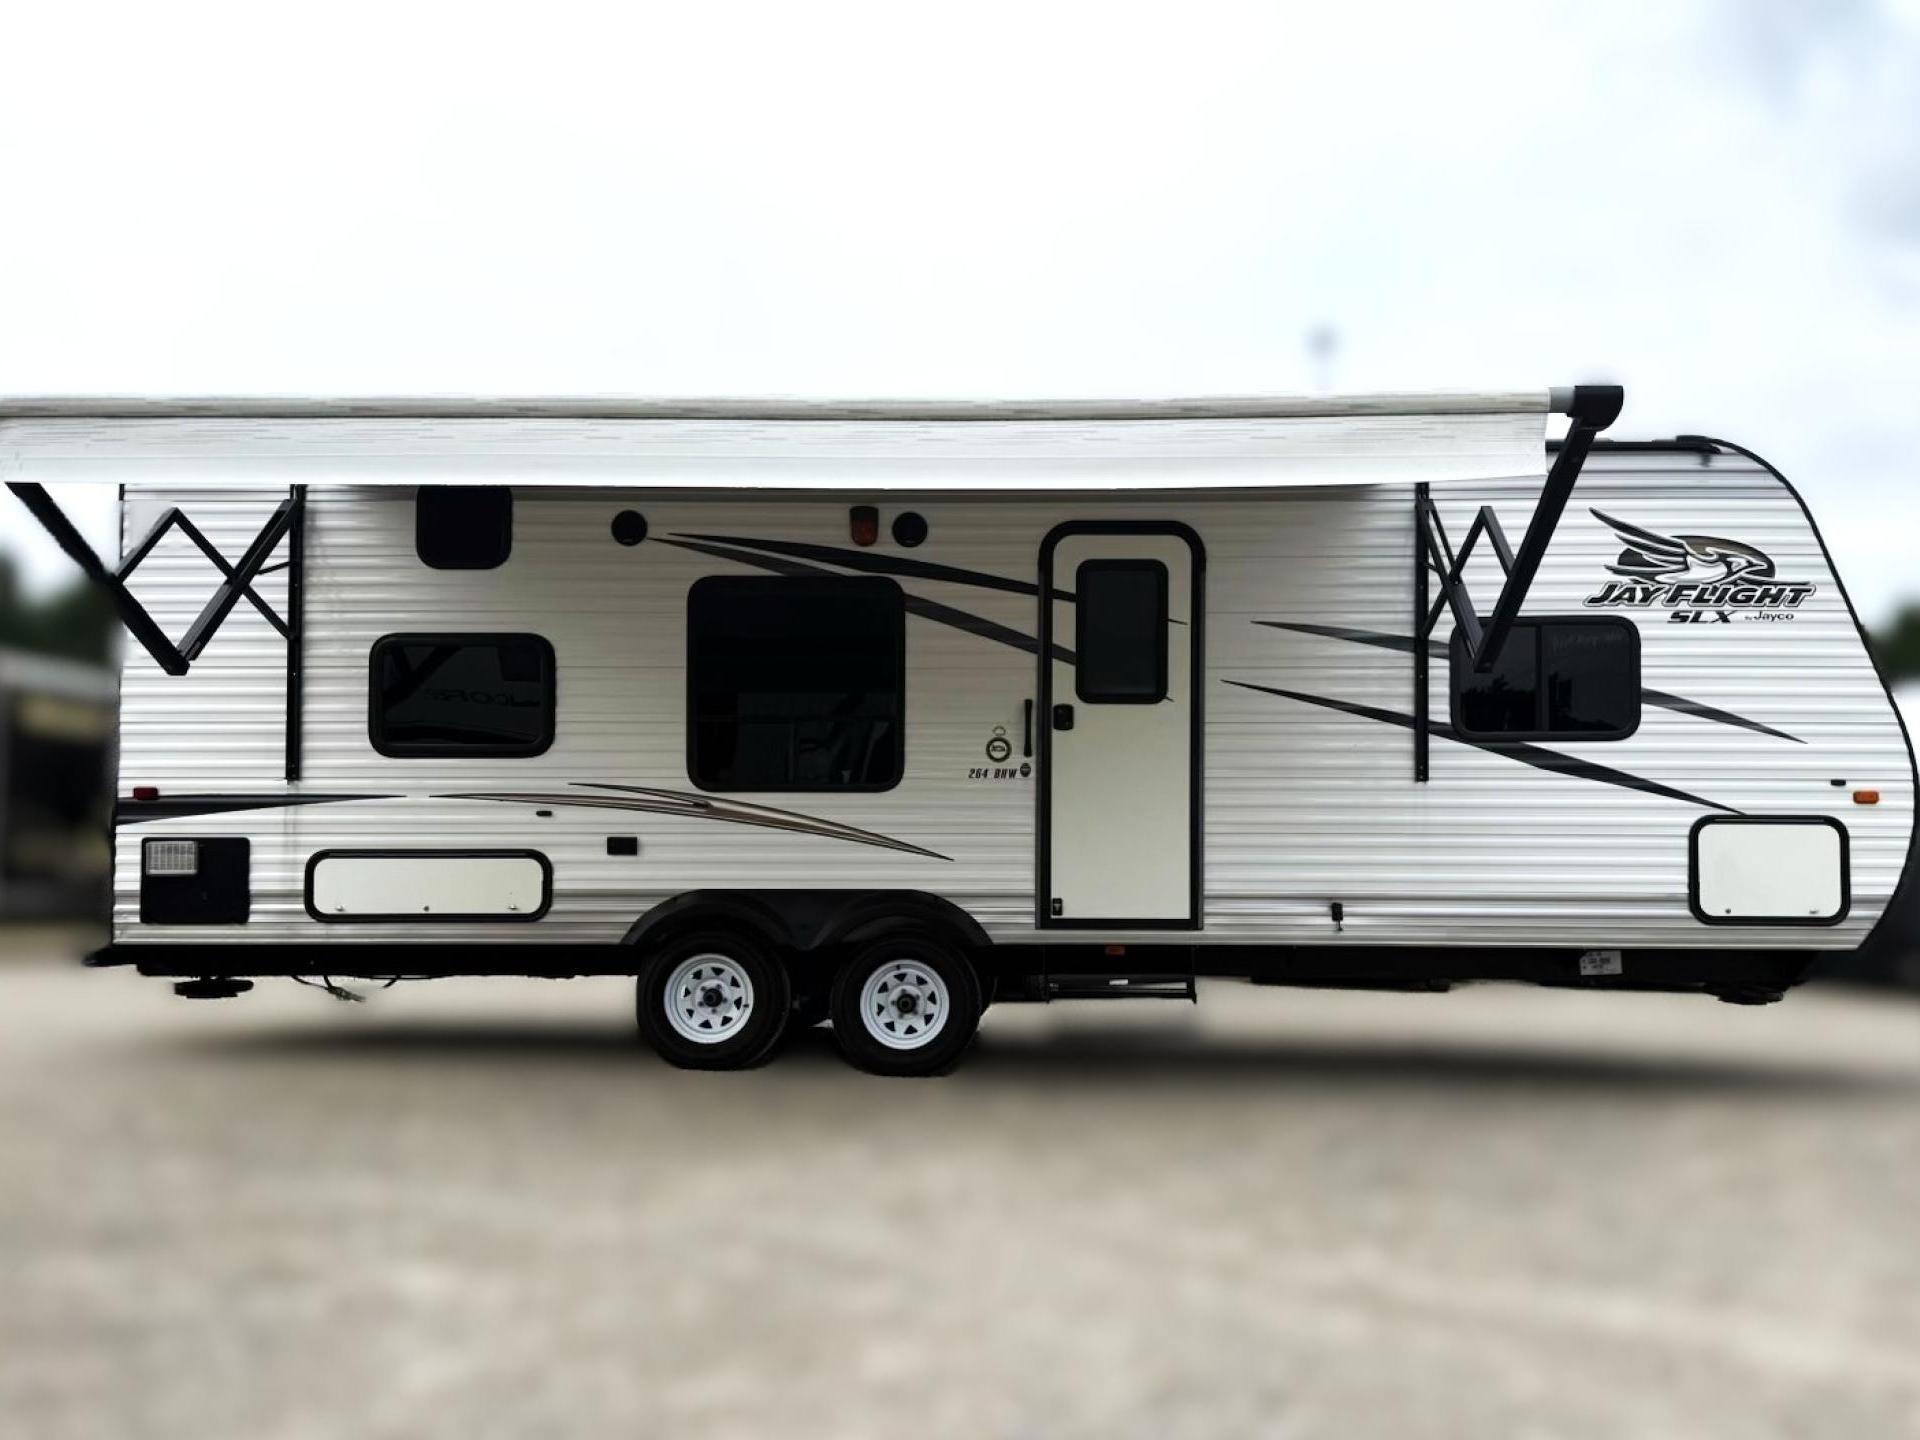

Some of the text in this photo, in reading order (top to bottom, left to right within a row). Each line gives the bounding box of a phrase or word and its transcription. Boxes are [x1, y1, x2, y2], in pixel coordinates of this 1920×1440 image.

[1586, 582, 1815, 607] JAY FLIGHT
[1667, 610, 1737, 623] SLX
[1753, 610, 1794, 621] Jayco
[968, 768, 988, 779] 264
